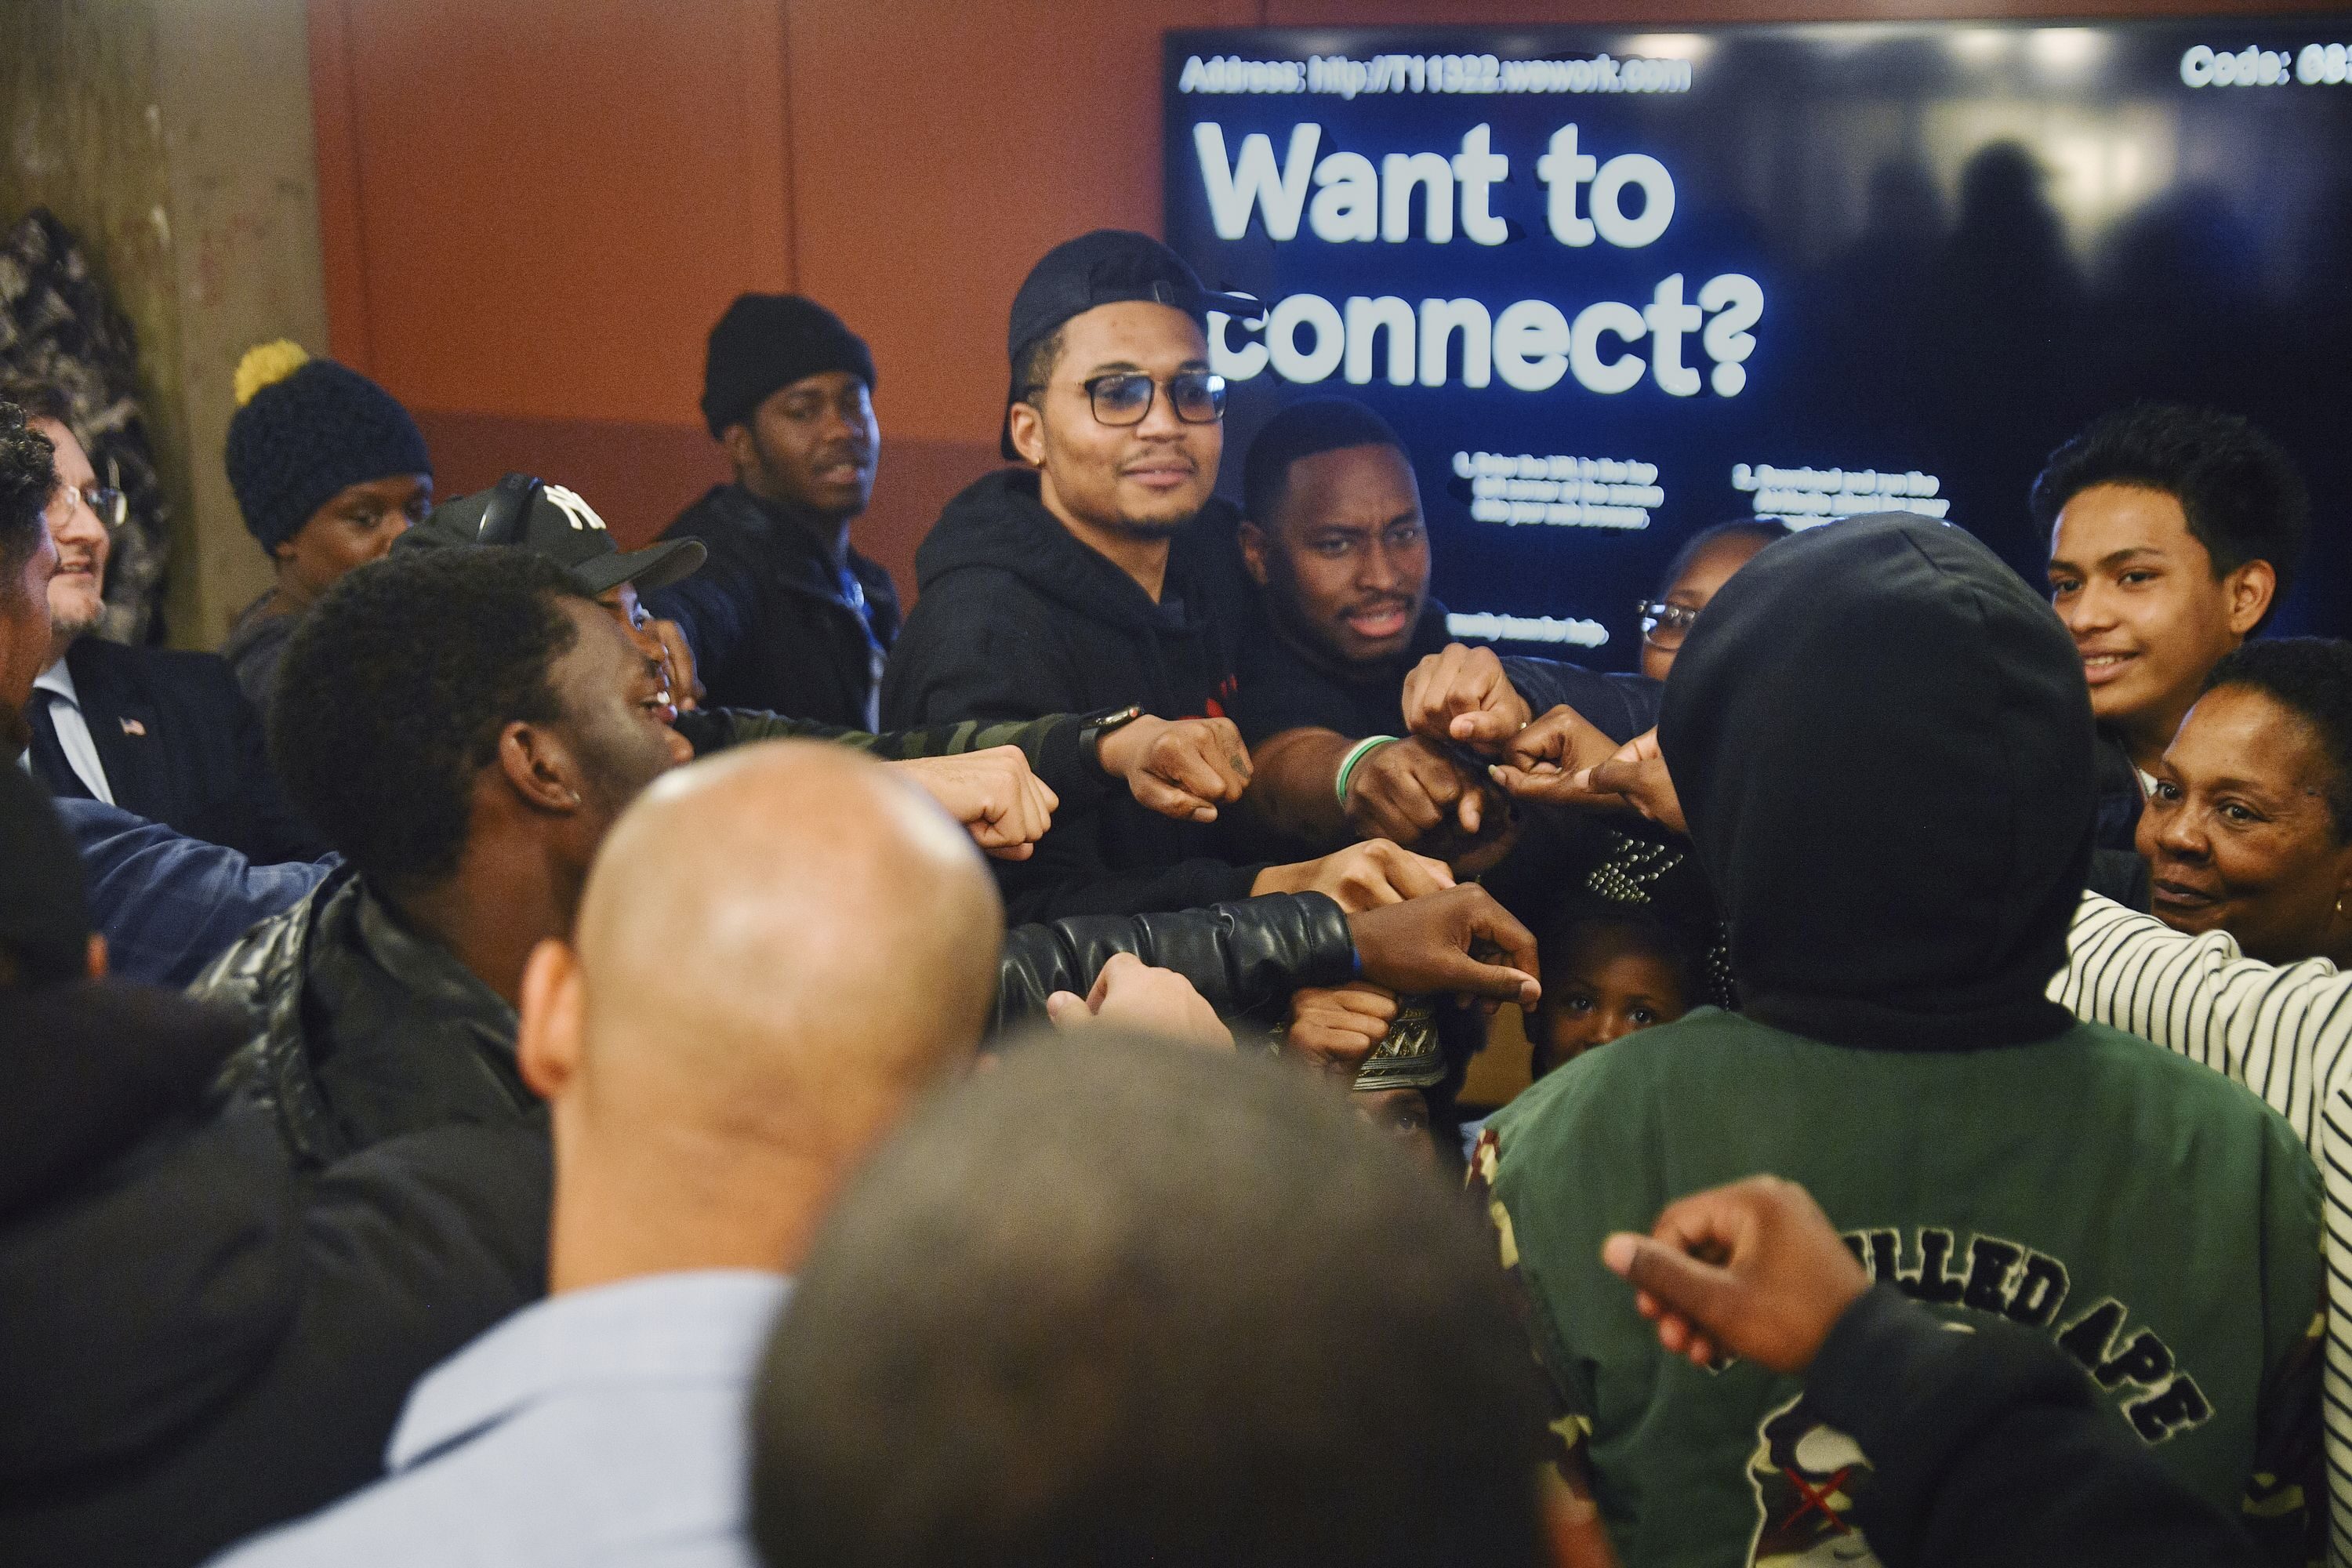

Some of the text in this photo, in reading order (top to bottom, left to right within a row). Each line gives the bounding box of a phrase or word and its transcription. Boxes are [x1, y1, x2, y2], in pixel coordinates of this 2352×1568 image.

[1179, 56, 1306, 94] Address:
[2180, 45, 2292, 88] Code:
[1192, 122, 1676, 247] Want to
[1207, 273, 1765, 397] connect?
[2053, 1295, 2216, 1446] APE
